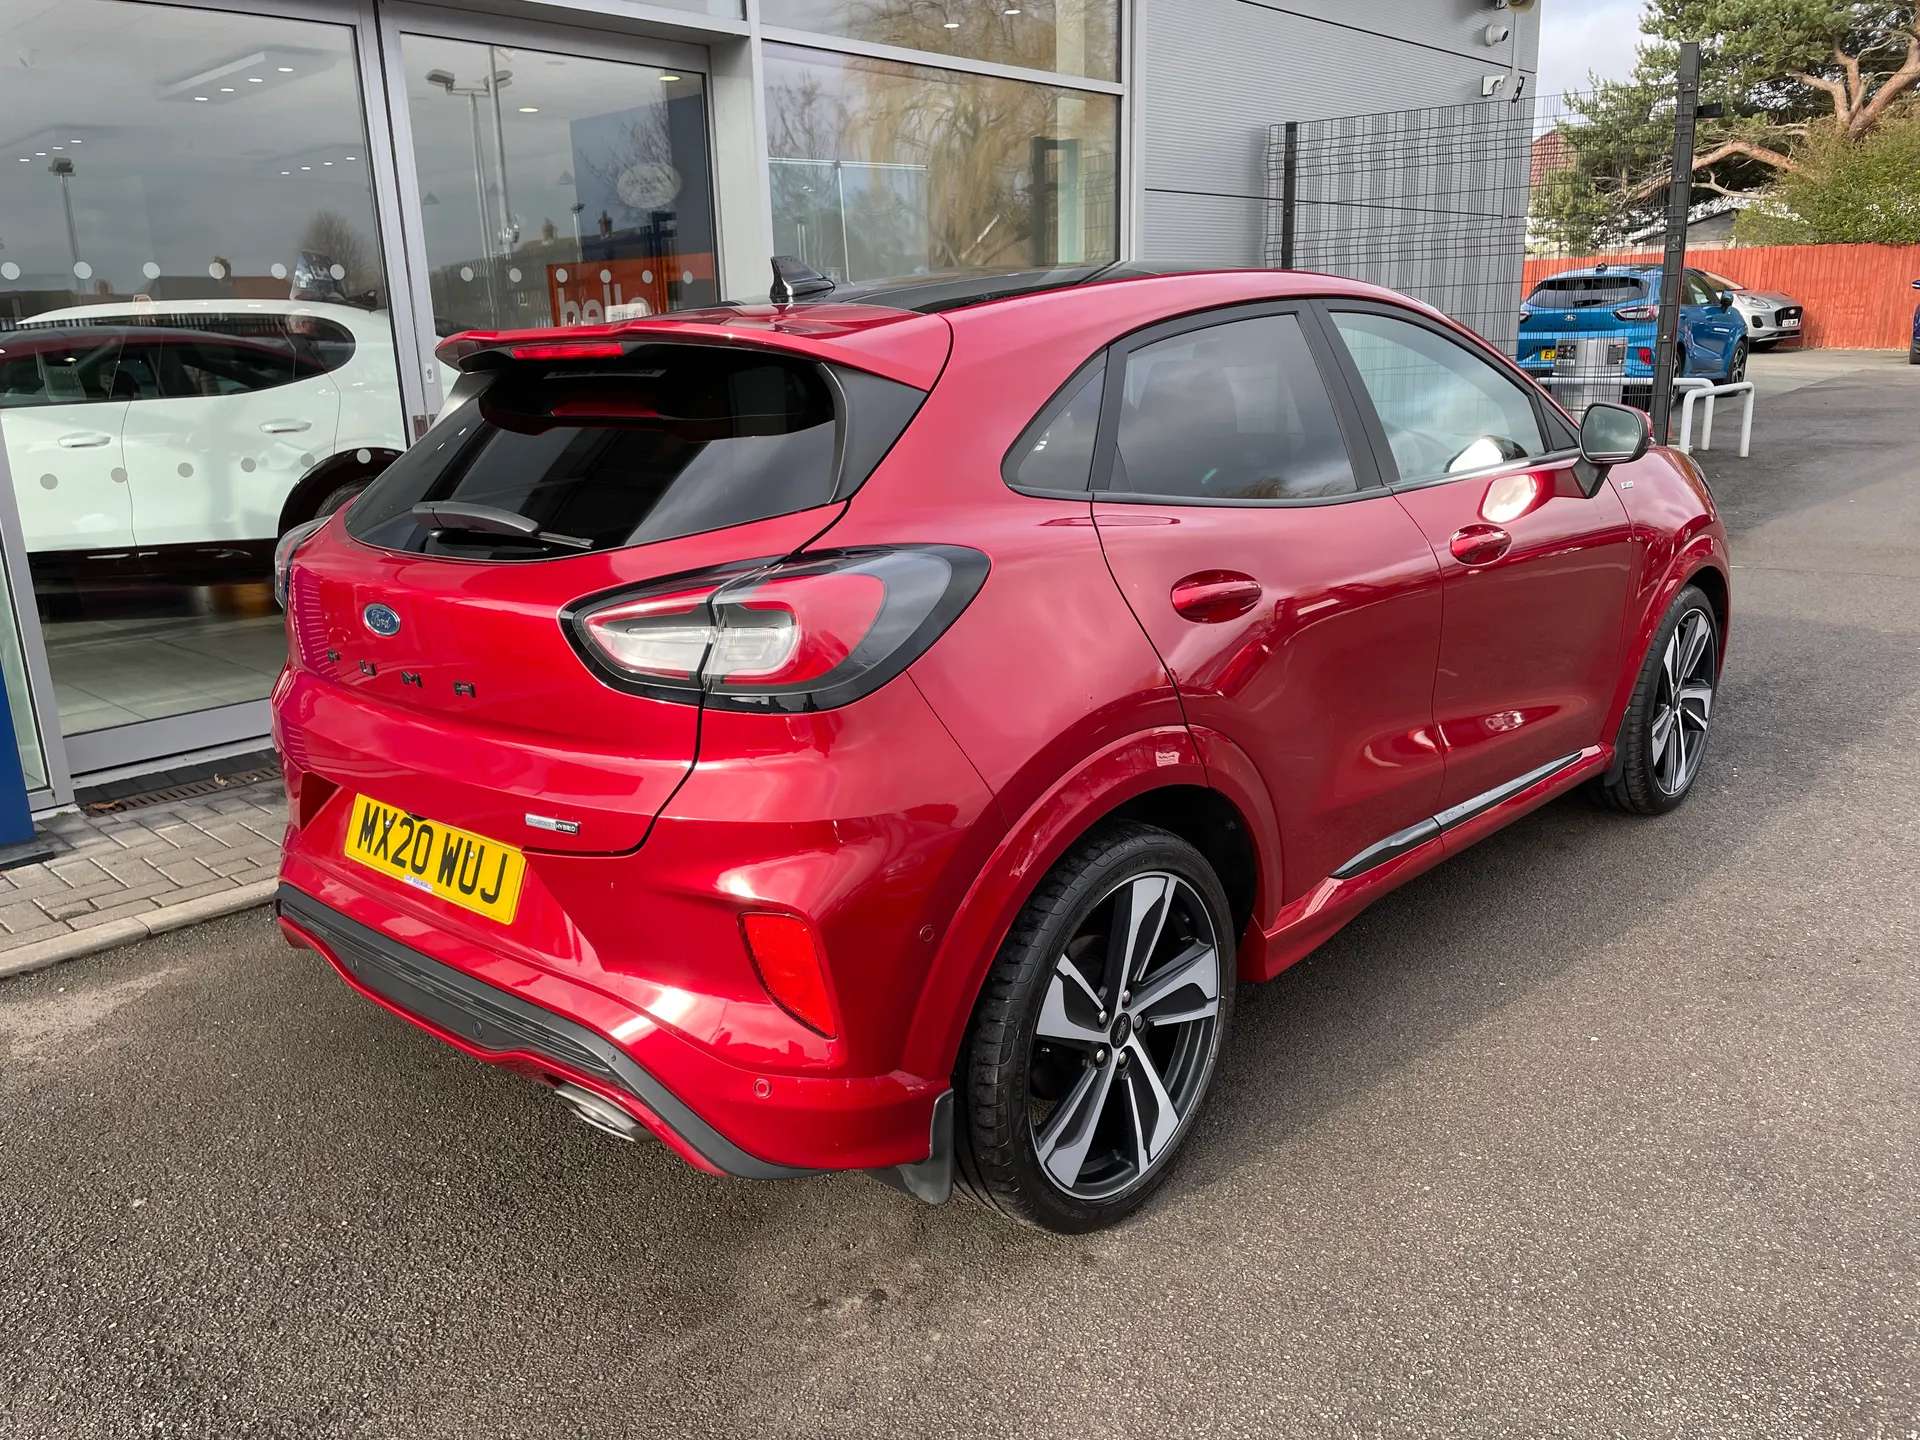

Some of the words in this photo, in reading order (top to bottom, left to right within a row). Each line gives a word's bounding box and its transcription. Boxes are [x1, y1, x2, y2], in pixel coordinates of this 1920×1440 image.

[327, 648, 476, 698] PUMA
[357, 802, 434, 875] MX20
[437, 832, 508, 905] WUJ
